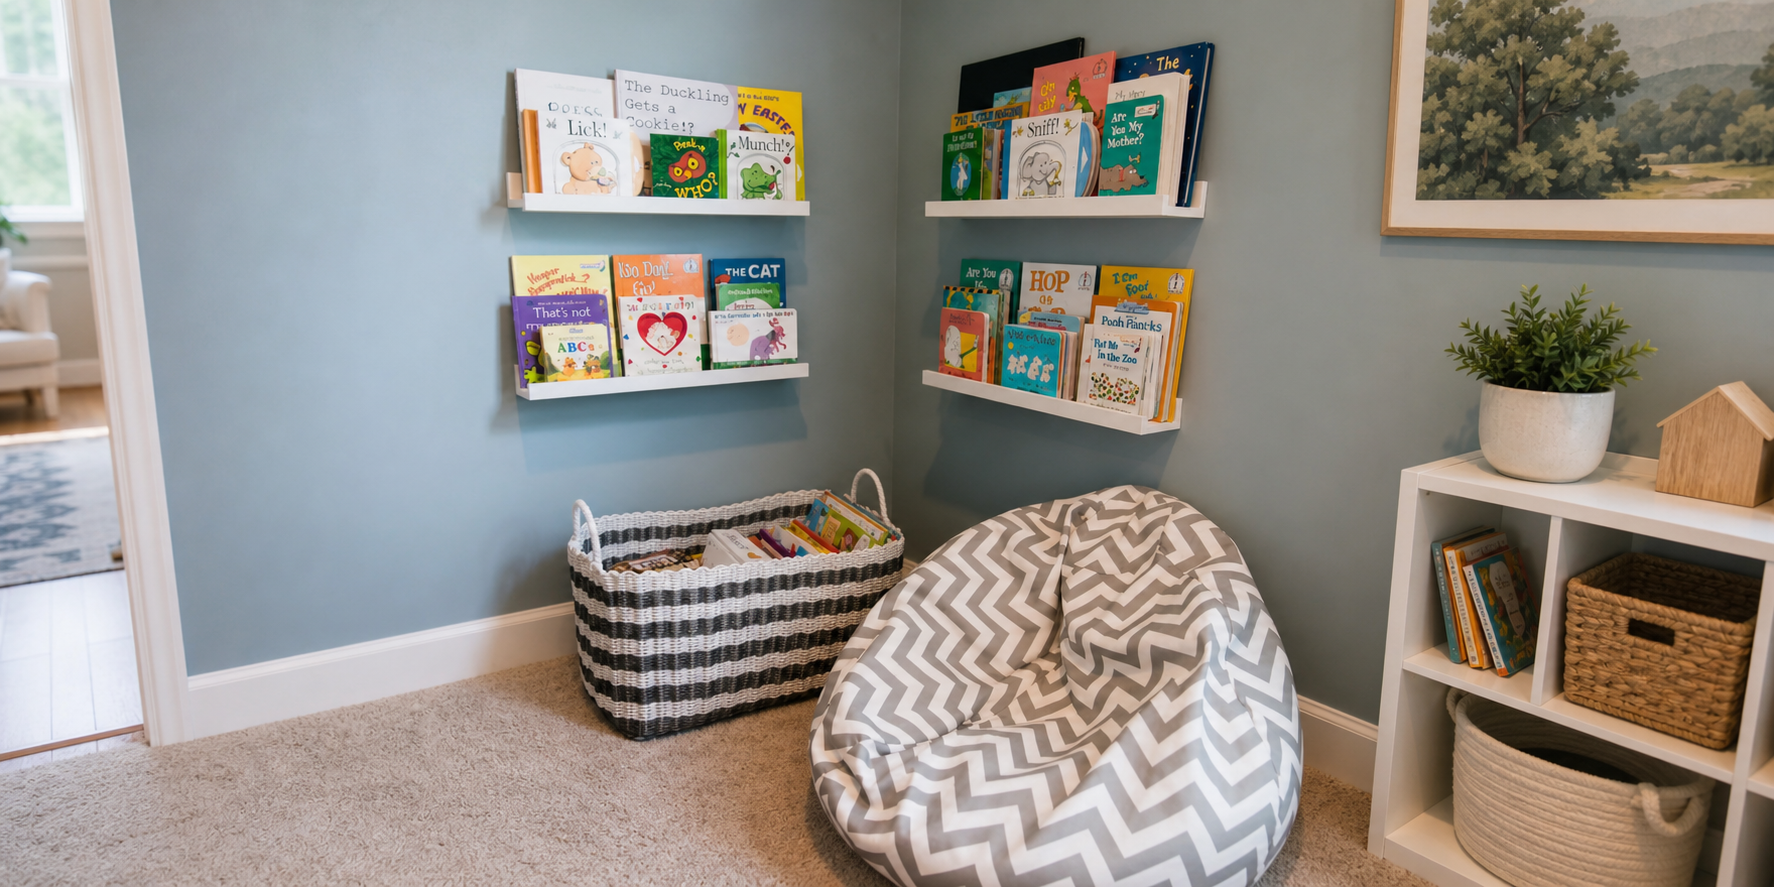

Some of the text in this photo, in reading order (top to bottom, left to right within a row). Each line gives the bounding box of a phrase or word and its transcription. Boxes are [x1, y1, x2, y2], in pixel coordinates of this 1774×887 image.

[1156, 56, 1179, 71] The
[624, 79, 652, 94] The
[660, 84, 729, 106] Duckling
[624, 98, 676, 114] Gets a
[1111, 113, 1127, 123] Are
[567, 119, 607, 138] Lick!
[1027, 117, 1060, 138] Sniff!
[1128, 121, 1144, 135] My
[738, 135, 785, 153] Munch!
[1107, 132, 1145, 149] Mother?
[674, 171, 718, 199] WHO?
[725, 264, 780, 279] THE CAT
[966, 267, 997, 278] Are You
[1029, 270, 1070, 293] HOP
[533, 306, 592, 319] That's not
[1107, 352, 1121, 363] the
[1121, 353, 1138, 364] Zoo
